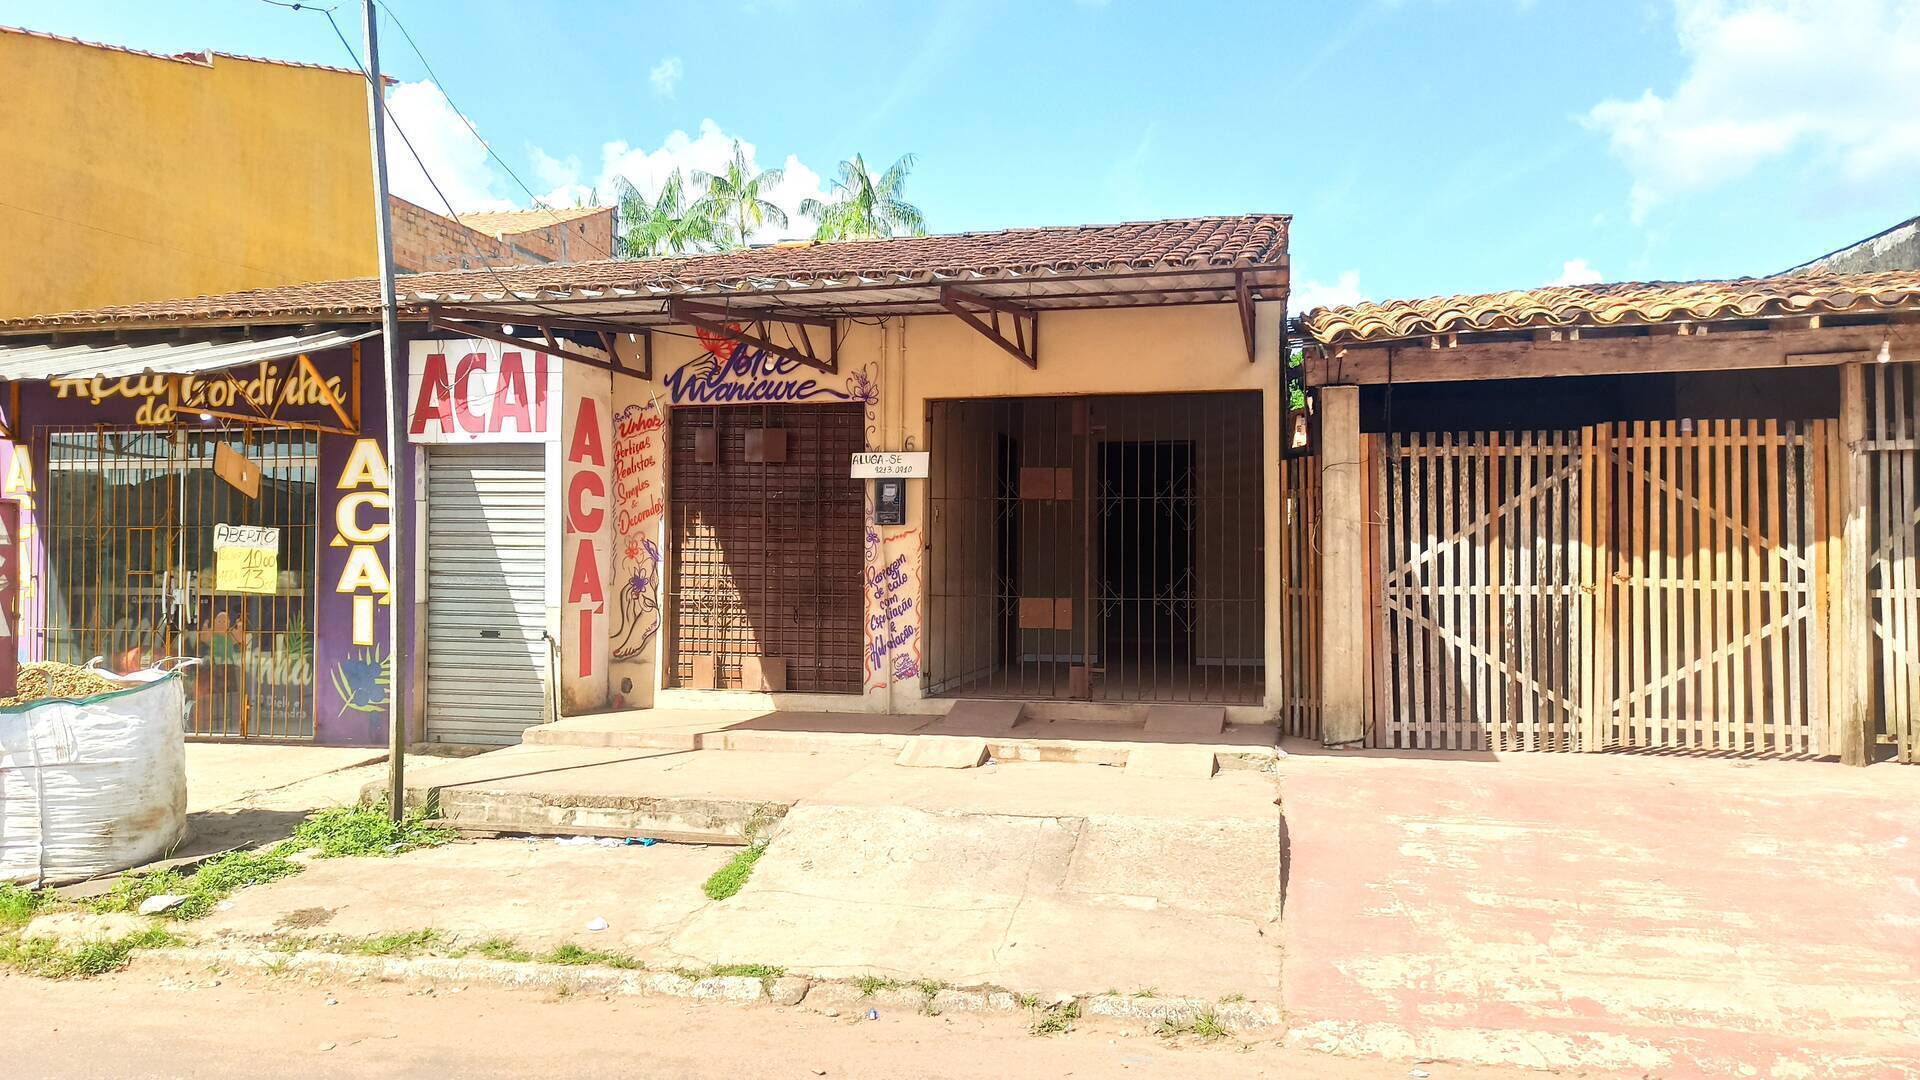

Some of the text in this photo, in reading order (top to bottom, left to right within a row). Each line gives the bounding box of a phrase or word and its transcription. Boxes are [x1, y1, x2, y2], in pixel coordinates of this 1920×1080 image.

[663, 366, 849, 404] Manicure
[136, 396, 176, 425] da
[619, 412, 662, 438] Unhas
[852, 454, 903, 465] ALUGA-SE
[217, 526, 276, 545] ABERTO
[874, 587, 884, 600] de
[880, 594, 898, 610] com
